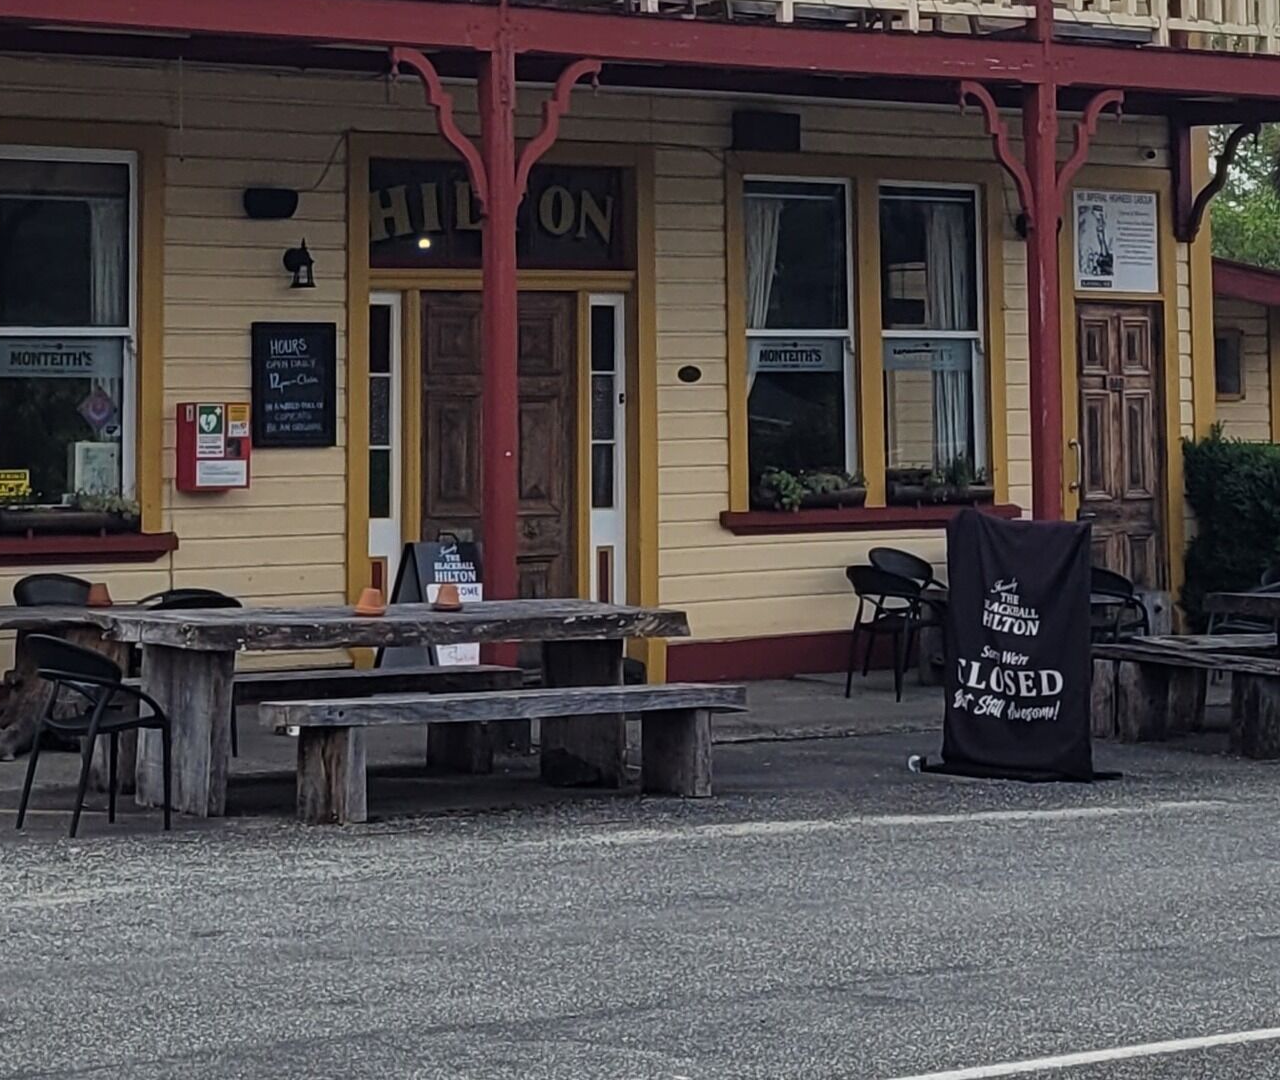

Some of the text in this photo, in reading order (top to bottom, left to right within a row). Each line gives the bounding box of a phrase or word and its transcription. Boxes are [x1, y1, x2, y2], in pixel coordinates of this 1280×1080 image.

[370, 181, 614, 245] HILON
[270, 338, 307, 356] HOURS
[10, 350, 94, 366] MONTEITH'S
[759, 348, 822, 363] MONTEITH'S
[434, 562, 475, 570] BLACKBALL
[435, 570, 476, 582] HILTON
[1000, 592, 1019, 605] THE
[973, 694, 1006, 719] Still
